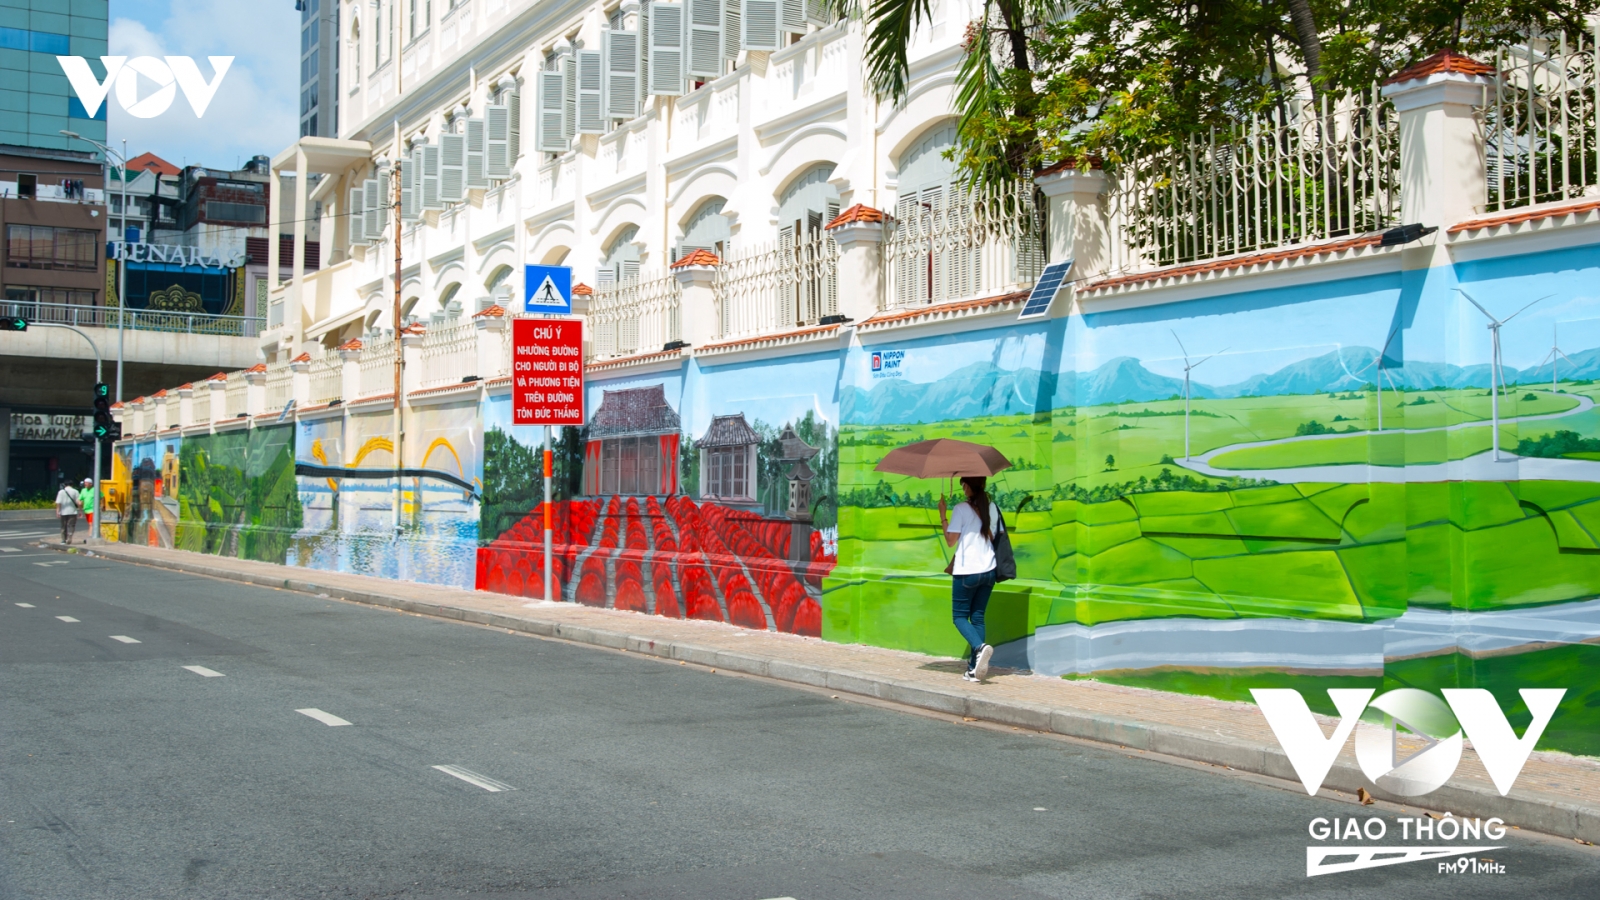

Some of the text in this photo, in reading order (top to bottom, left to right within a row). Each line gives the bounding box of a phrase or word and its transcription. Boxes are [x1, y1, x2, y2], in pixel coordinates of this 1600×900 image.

[112, 241, 241, 269] BENARAS
[533, 325, 562, 339] CHÚ Ý
[517, 343, 579, 356] NHƯỜNG ĐƯỜNG
[883, 350, 905, 360] NIPPON
[515, 359, 579, 373] CHO NGƯỜI ĐI BỘ
[884, 360, 901, 369] PAINT
[517, 375, 580, 389] VÀ PHƯƠNG TIỆN
[101, 385, 108, 395] 9
[524, 391, 574, 403] TRÊN ĐƯỜNG
[516, 404, 580, 418] TÔN ĐỨC THẮNG
[11, 413, 42, 426] Hoa
